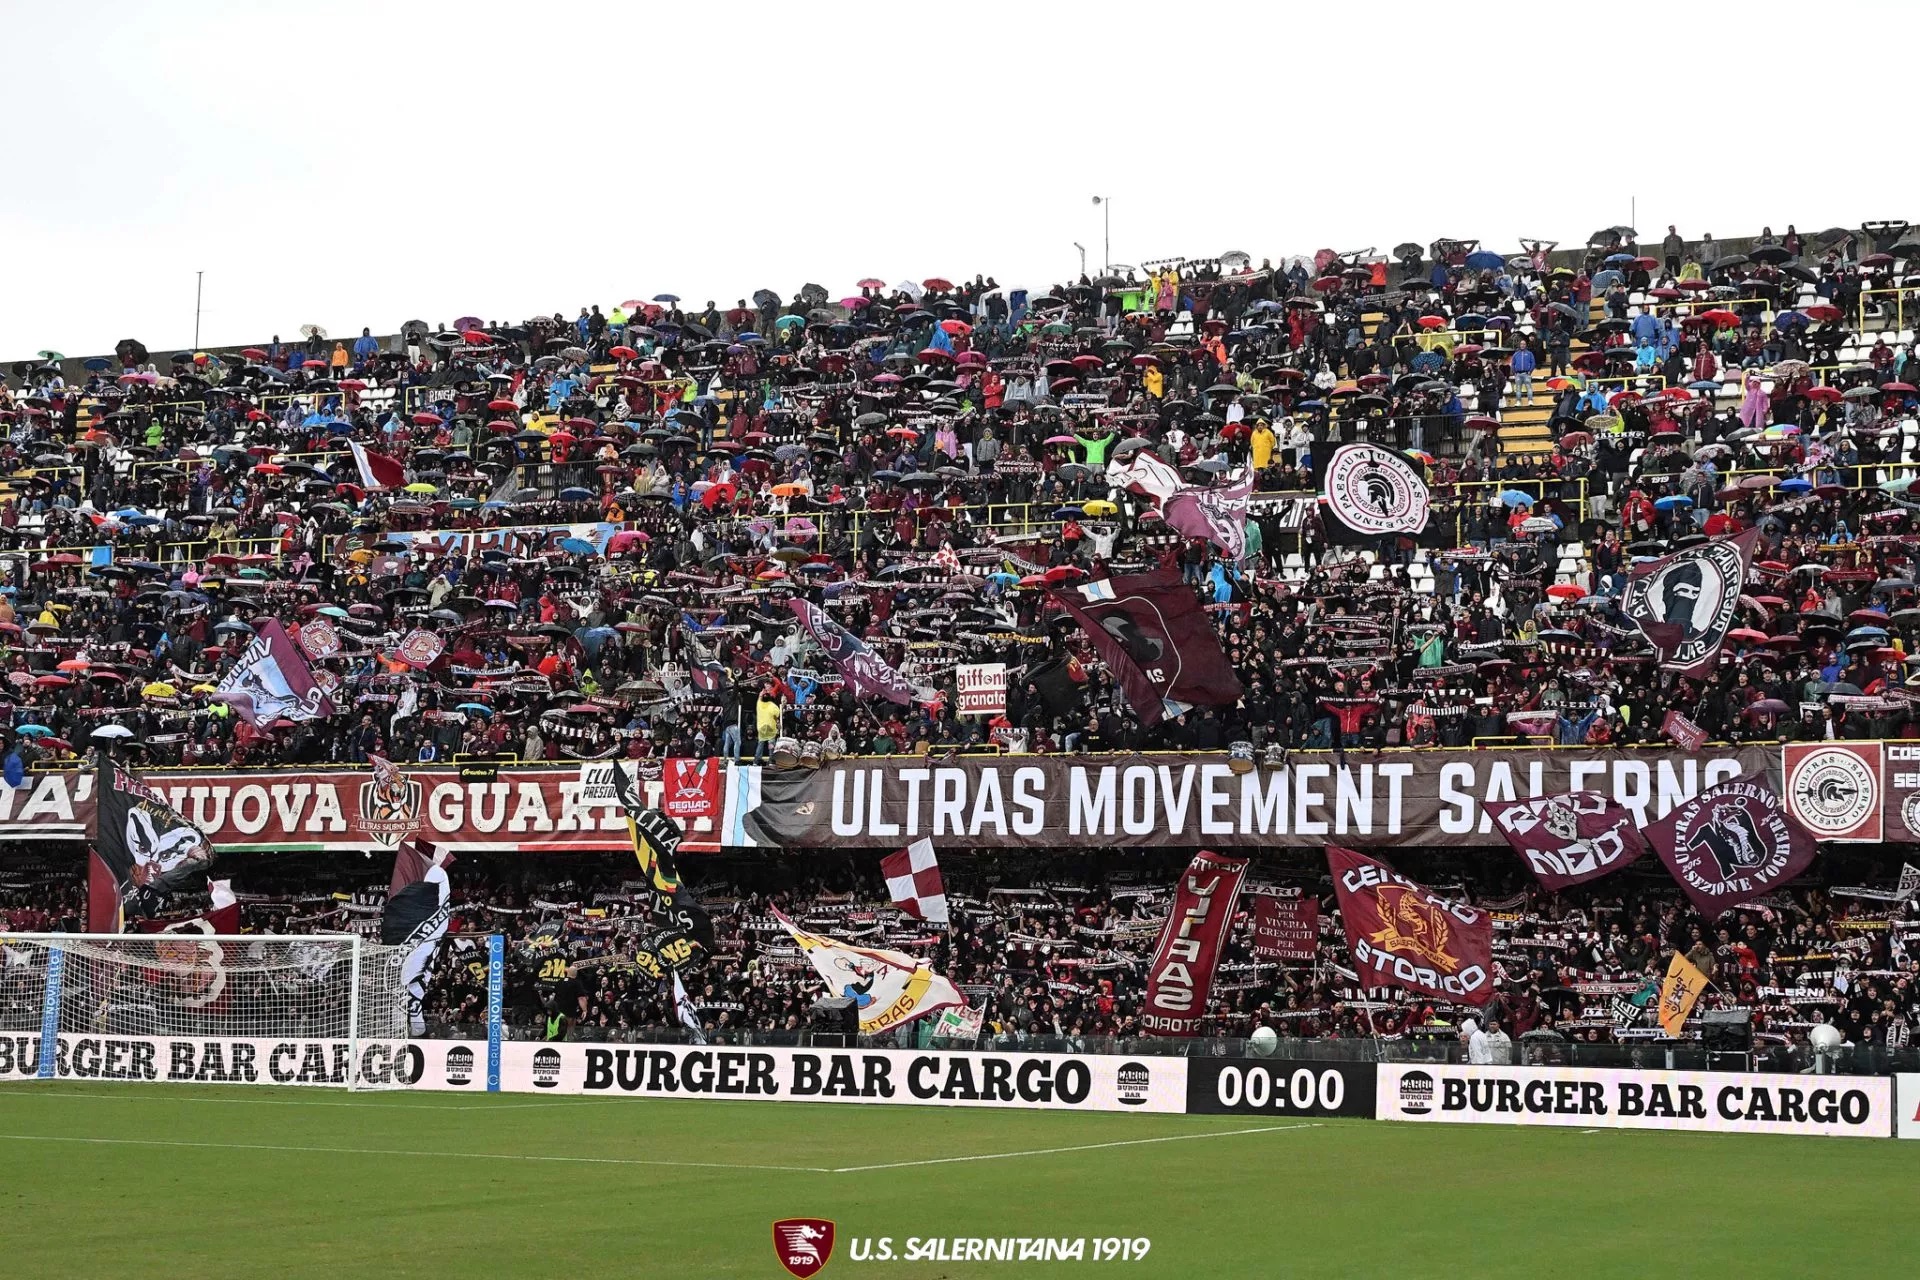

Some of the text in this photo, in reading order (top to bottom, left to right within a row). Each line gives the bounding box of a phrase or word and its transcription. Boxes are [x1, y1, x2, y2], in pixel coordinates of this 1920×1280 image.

[1336, 451, 1366, 511] PAESTUM
[1376, 452, 1424, 500] ULTRAS
[958, 692, 1006, 710] granata
[831, 766, 1046, 836] ULTRAS
[1069, 764, 1414, 836] MOVEMENT
[1799, 756, 1869, 826] ULTRAS SALERNO PAESTUM
[1674, 782, 1776, 865] ULTRAS SALERNO
[1684, 869, 1753, 896] SEZIONE
[1265, 918, 1308, 929] VIVERLA
[1274, 902, 1299, 911] NATI
[1278, 911, 1295, 919] PER
[1259, 928, 1313, 940] CRESCIUTI
[1277, 940, 1295, 948] PER
[1355, 938, 1487, 996] STORICO
[168, 1042, 258, 1082] BAR
[269, 1043, 425, 1085] CARGO
[584, 1049, 1091, 1103] BURGER BAR CARGO
[1217, 1066, 1344, 1110] 00:00
[1442, 1078, 1870, 1123] BURGER BAR CARGO
